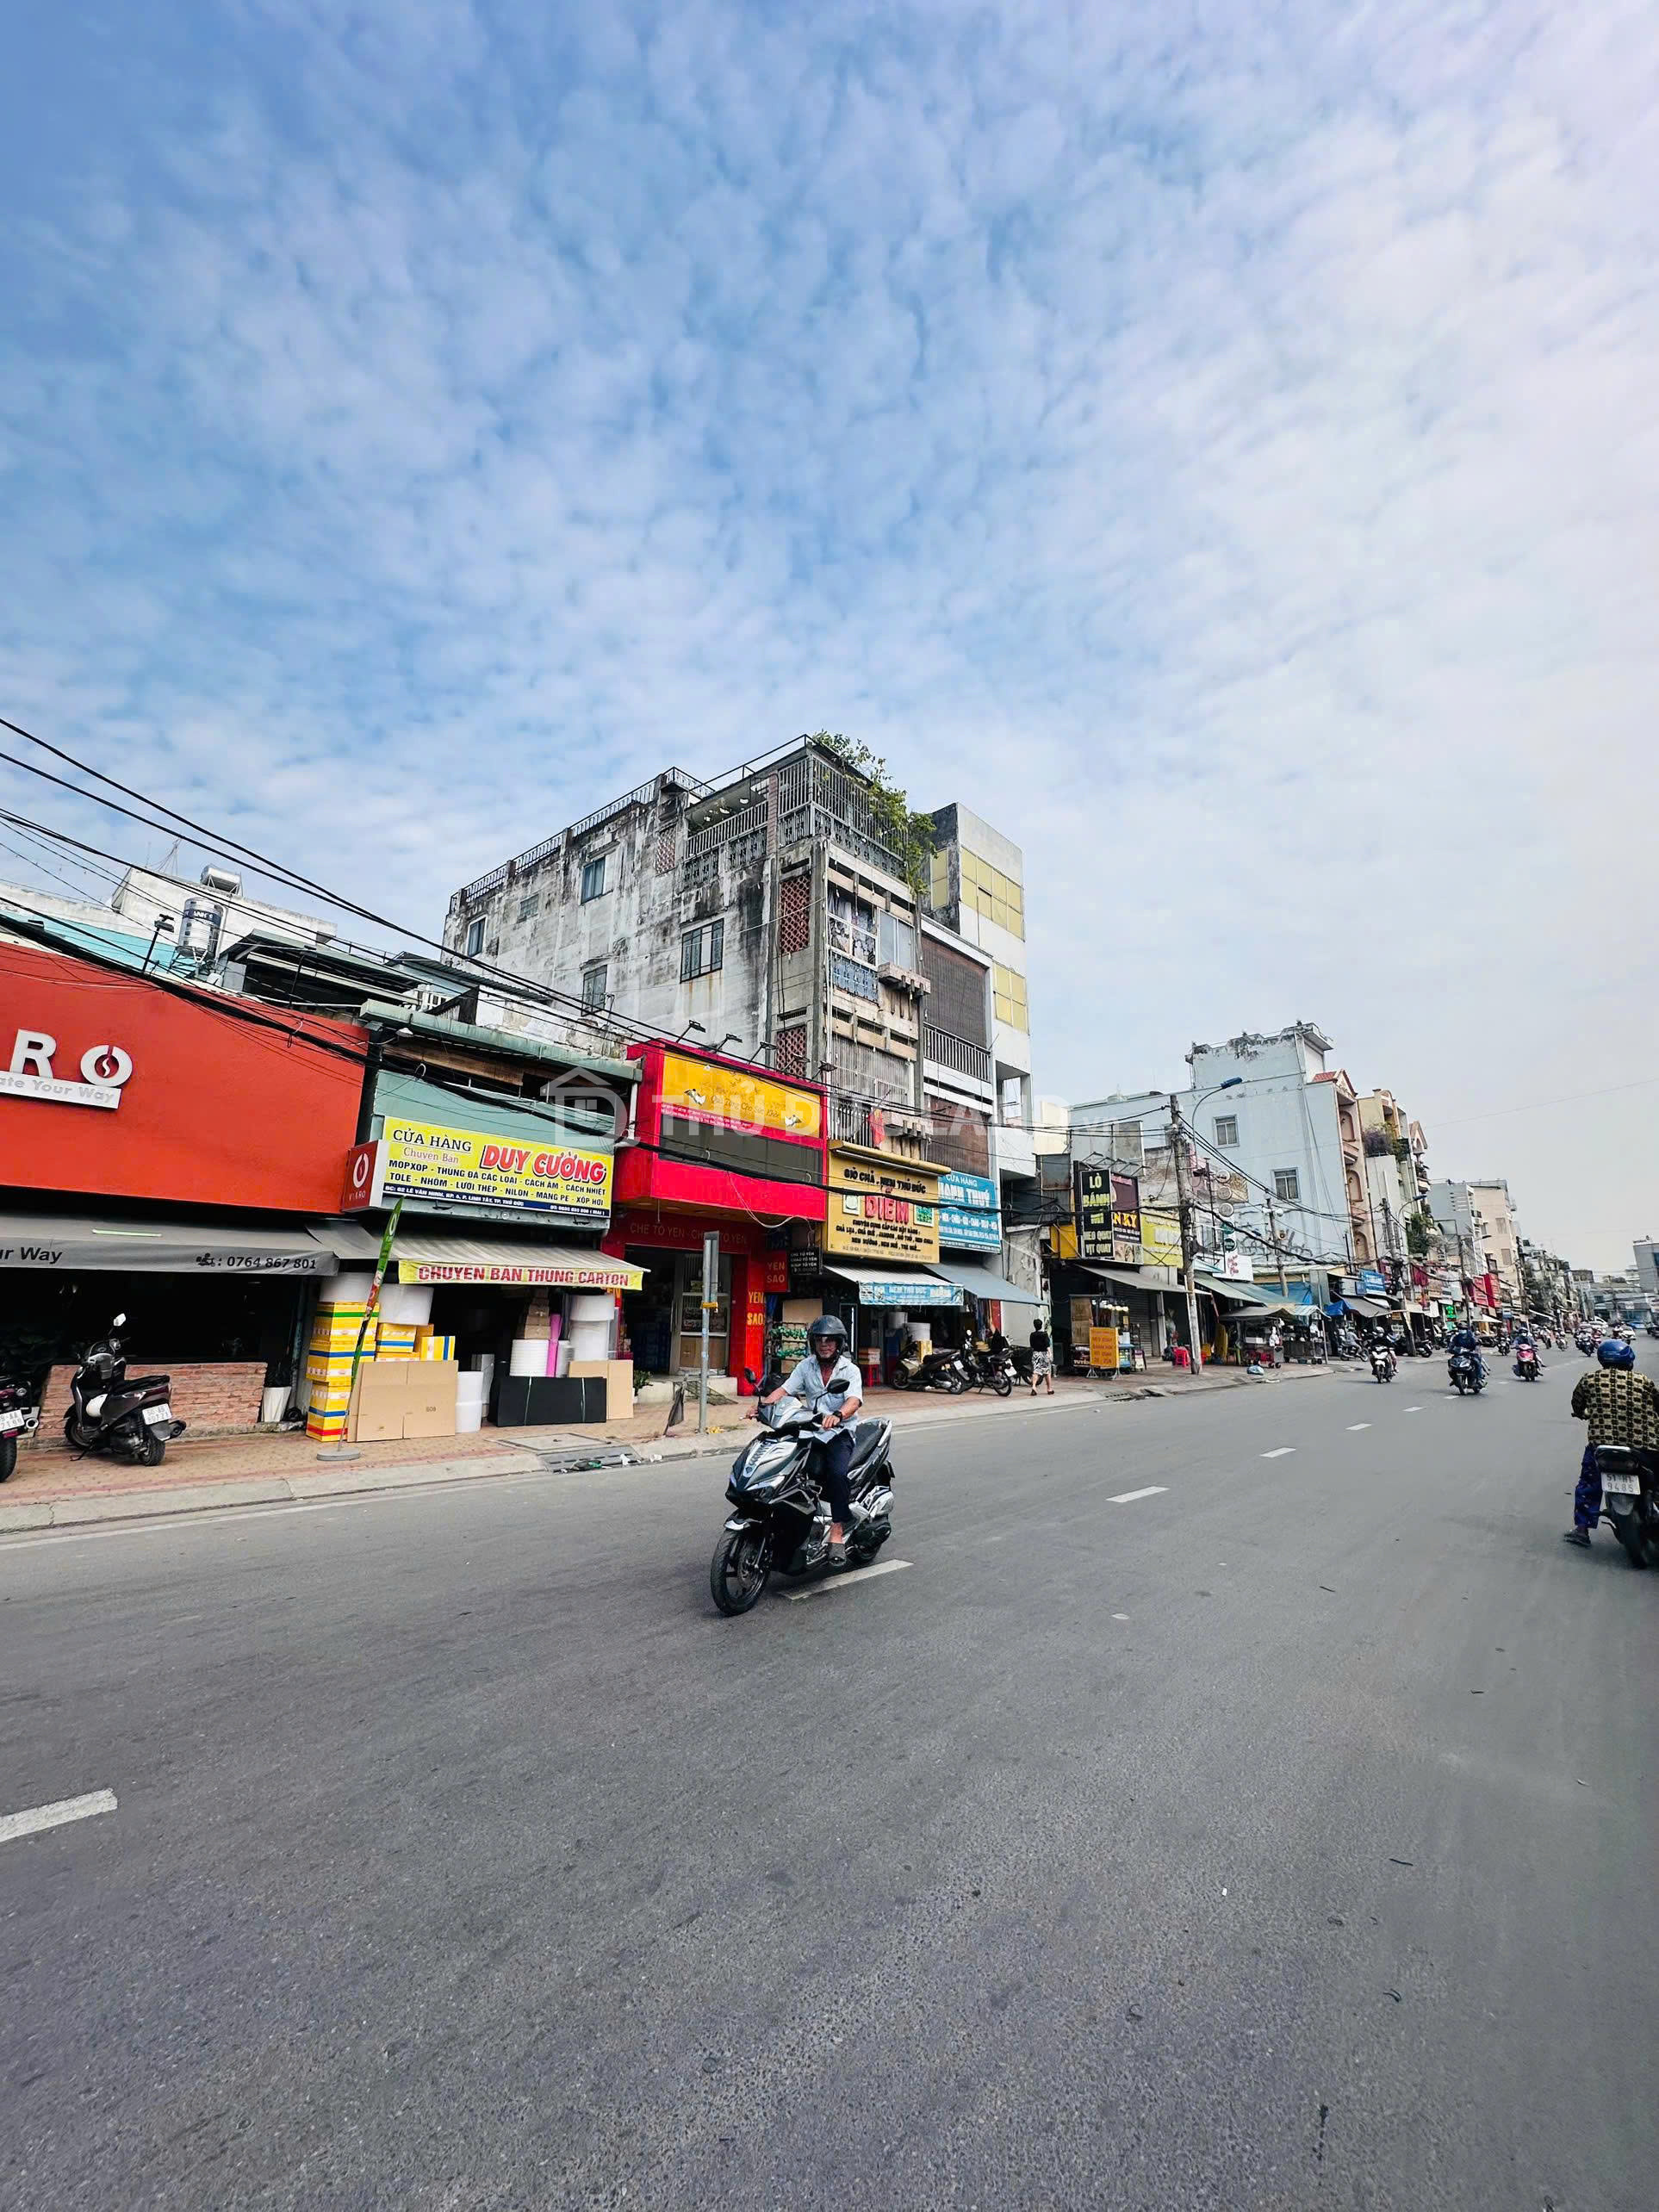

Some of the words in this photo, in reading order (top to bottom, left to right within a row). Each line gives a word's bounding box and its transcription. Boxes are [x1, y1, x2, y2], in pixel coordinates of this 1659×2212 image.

[33, 1079, 72, 1095] Your
[78, 1085, 114, 1103] Way
[393, 1128, 424, 1144] CỬA
[430, 1134, 472, 1153] HÀNG
[482, 1144, 531, 1172] DUY
[1089, 1172, 1103, 1189] LÒ
[1083, 1192, 1110, 1207] BÁNH
[21, 1247, 63, 1264] Way
[227, 1256, 261, 1269] 0764
[265, 1258, 290, 1268] 867
[294, 1258, 316, 1269] 801
[578, 1271, 629, 1287] CARTON
